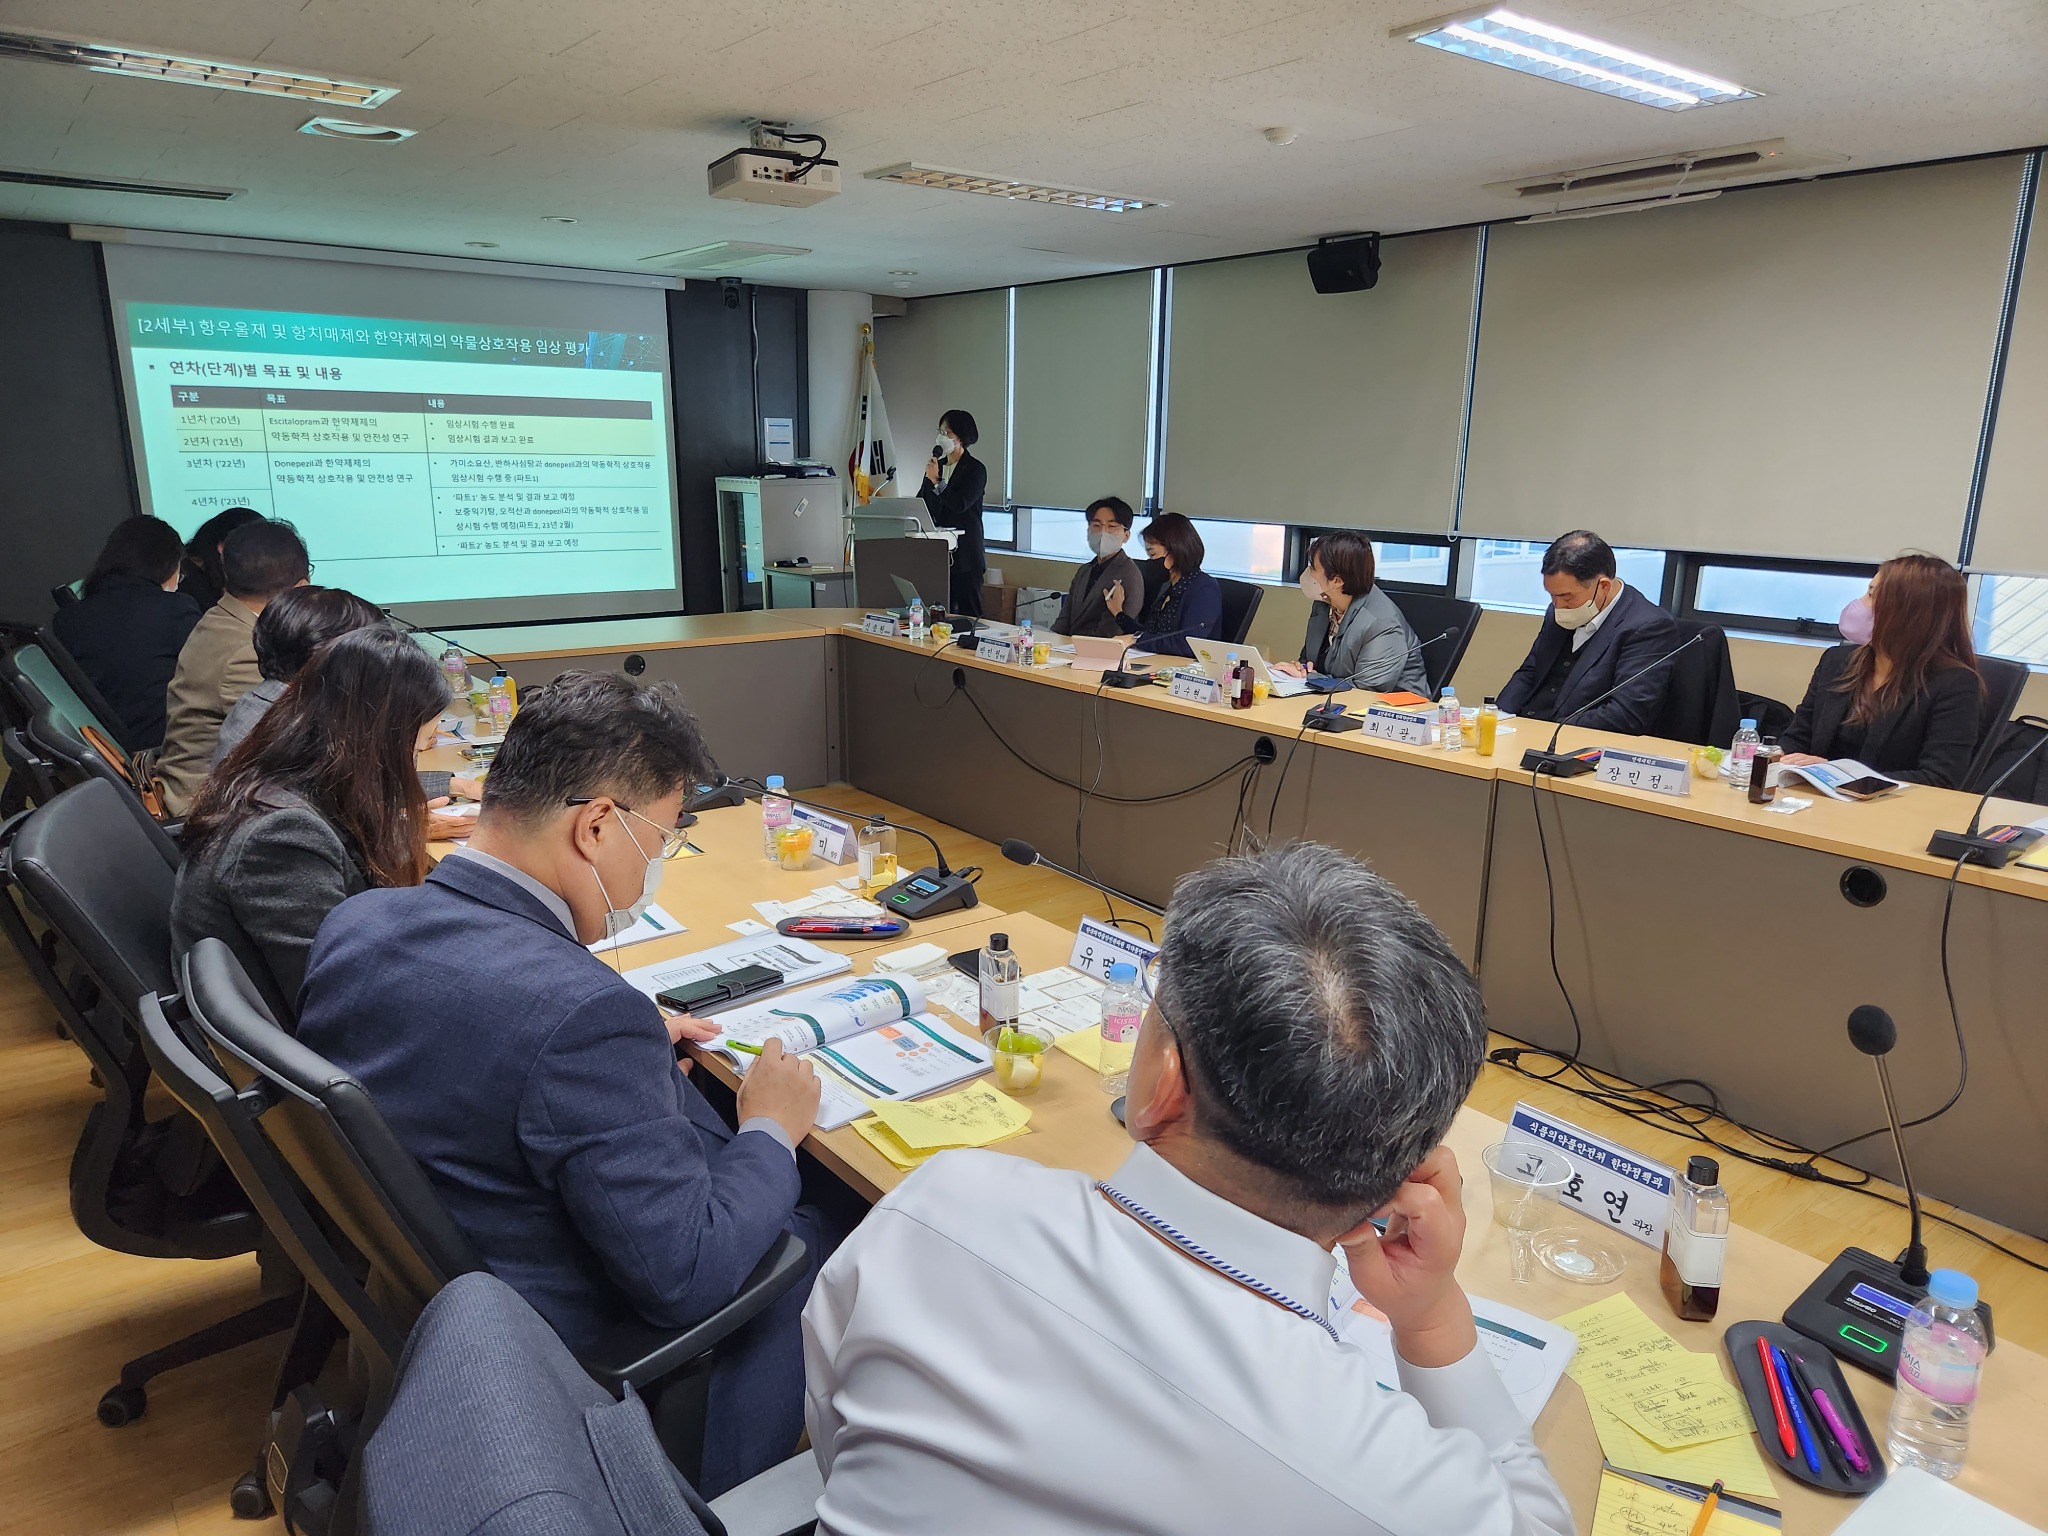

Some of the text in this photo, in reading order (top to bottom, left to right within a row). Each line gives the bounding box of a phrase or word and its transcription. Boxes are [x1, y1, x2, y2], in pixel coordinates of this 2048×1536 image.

[138, 317, 590, 356] [2세부] 항우울제 및 항치매제와 한약제제의 약물상호작용 임상 평가
[169, 361, 343, 381] 연차(단계)별 목표 및 내용
[178, 391, 200, 403] 구분
[266, 394, 286, 404] 목표
[428, 399, 446, 409] 내용
[181, 415, 207, 425] 1년차
[184, 437, 210, 448] 2년차
[187, 458, 213, 469] 3년차
[191, 496, 218, 507] 4년차
[1528, 1121, 1665, 1190] 식품의약품안전처 한약정책과
[1632, 1218, 1654, 1237] 과장
